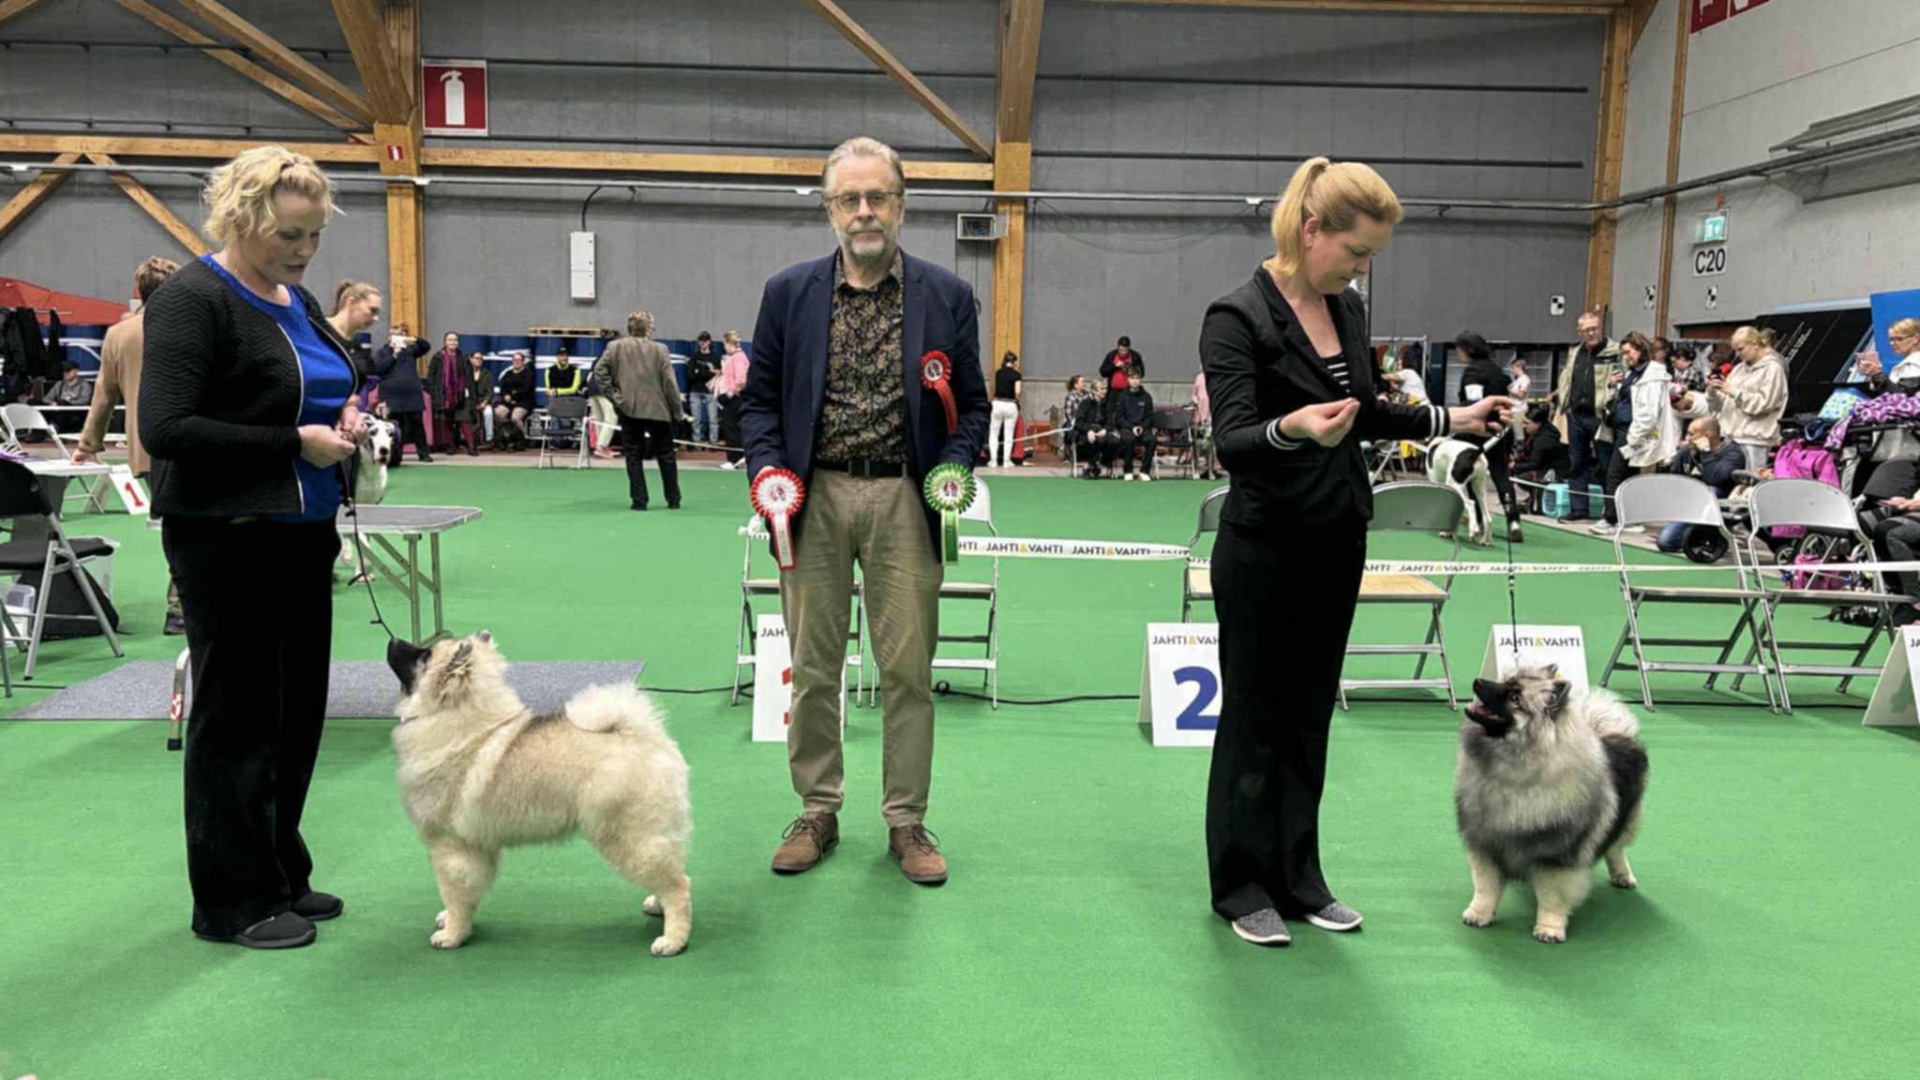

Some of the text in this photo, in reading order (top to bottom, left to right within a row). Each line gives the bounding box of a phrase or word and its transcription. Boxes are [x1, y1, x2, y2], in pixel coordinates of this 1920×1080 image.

[1695, 248, 1726, 274] C20
[124, 482, 144, 507] 1
[986, 542, 1063, 554] JAHTI&VAHTI
[760, 627, 785, 637] JAH
[1500, 637, 1580, 647] JAHTI&VAHTI
[1172, 666, 1220, 731] 2
